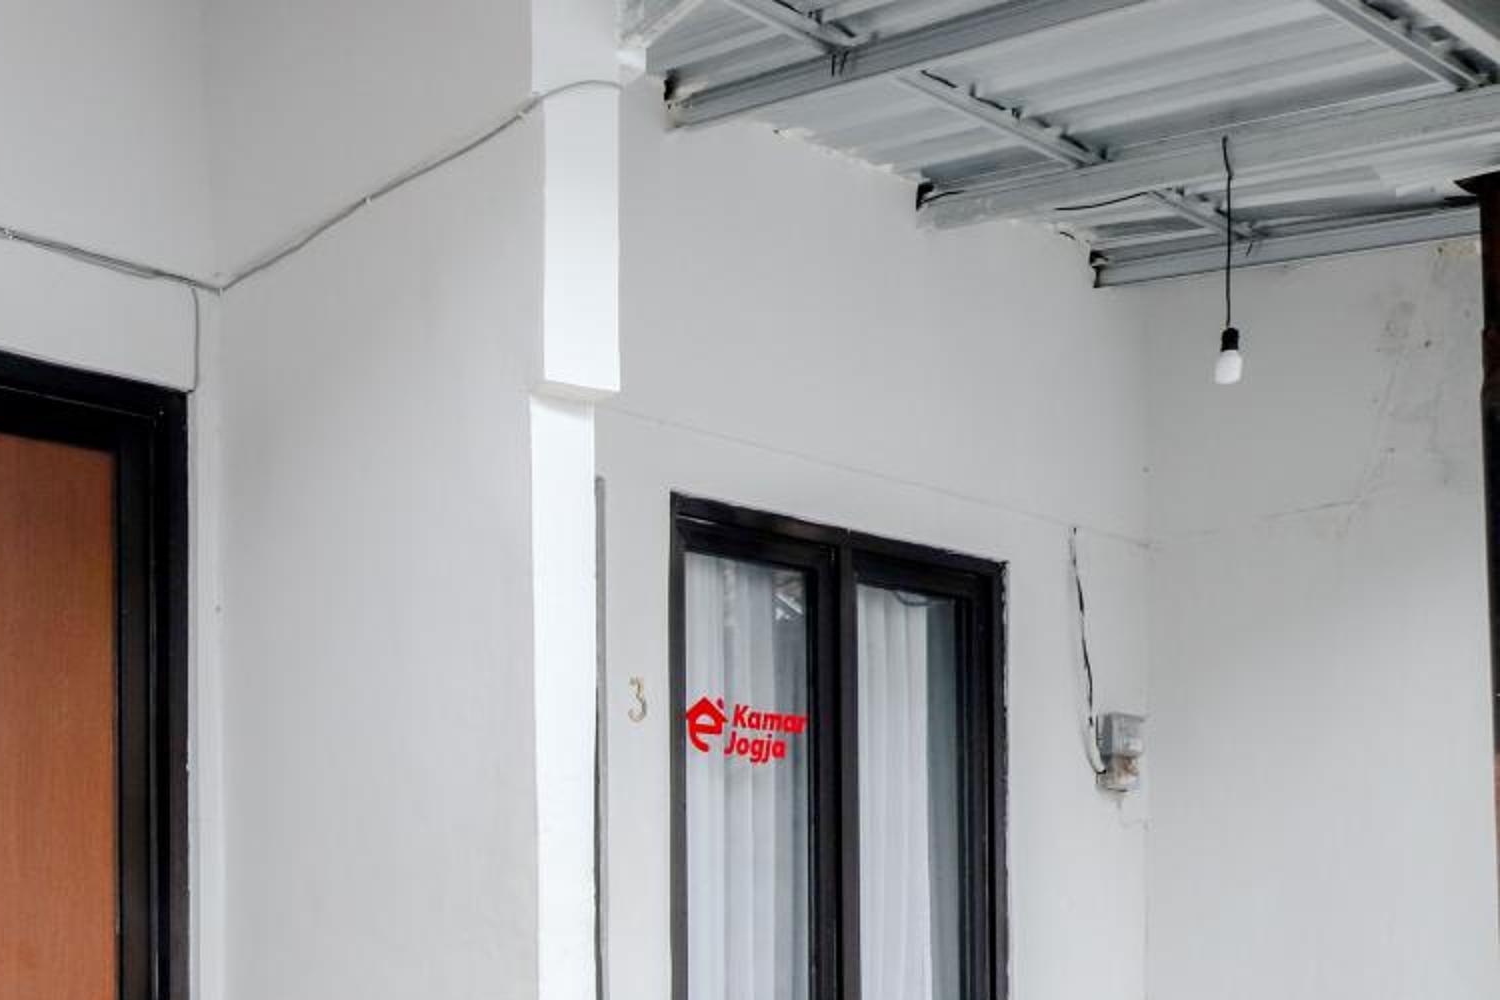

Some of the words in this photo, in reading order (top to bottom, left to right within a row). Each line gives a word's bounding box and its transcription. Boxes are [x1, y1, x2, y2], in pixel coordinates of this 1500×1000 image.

[627, 675, 647, 723] 3
[732, 703, 808, 735] Kamar
[723, 730, 788, 765] Jogja
